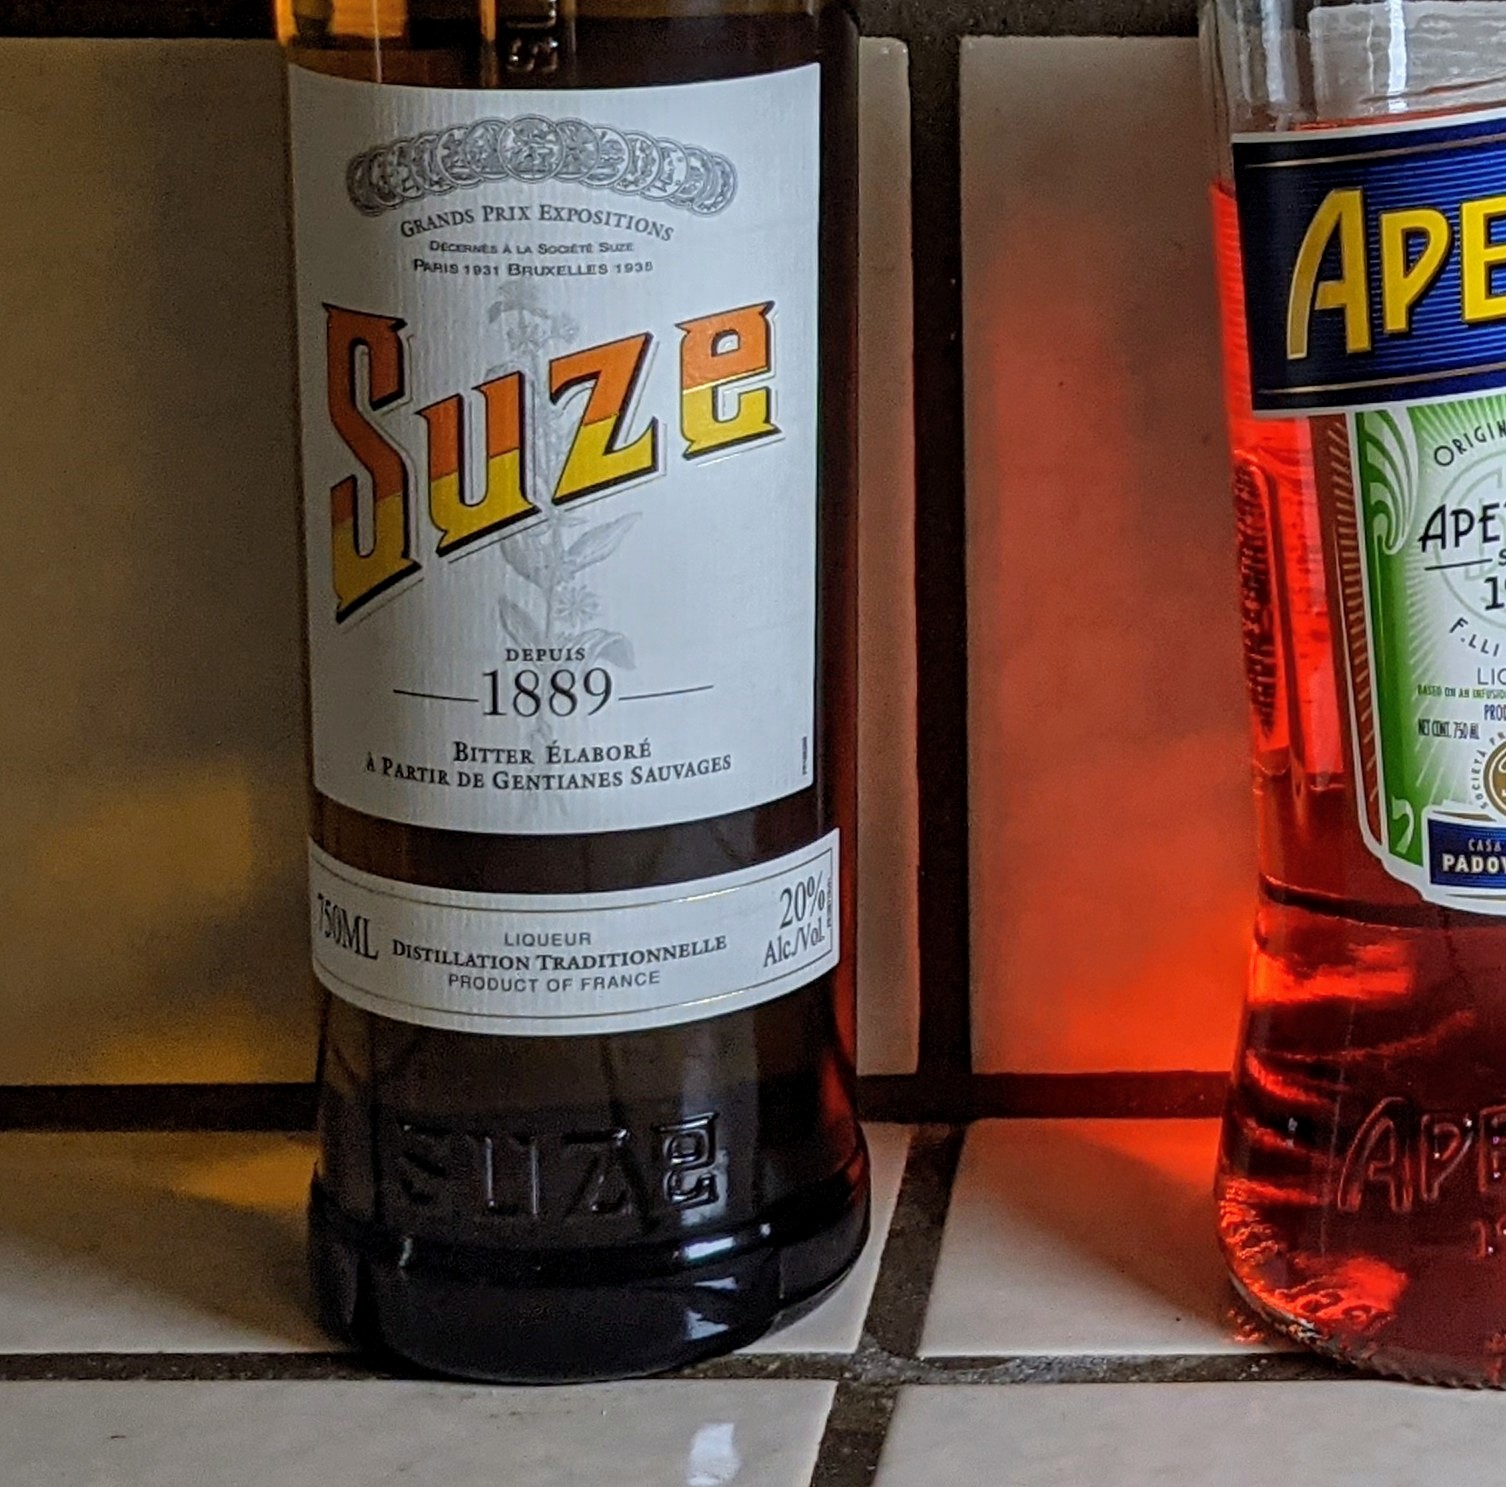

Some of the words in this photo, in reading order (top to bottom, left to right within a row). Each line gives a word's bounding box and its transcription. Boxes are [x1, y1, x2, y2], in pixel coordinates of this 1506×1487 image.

[400, 208, 474, 239] GRANDS
[482, 204, 531, 223] PRIX
[539, 204, 674, 242] EXPOSITIONS
[599, 241, 635, 253] SUZE
[414, 258, 459, 274] PARIS
[464, 264, 499, 276] 1931
[508, 262, 609, 276] BRUXELLES
[505, 647, 586, 662] DEPUIS
[481, 667, 613, 717] 1889
[453, 741, 535, 764] BITTER
[546, 738, 652, 764] ÉLABORÉ
[382, 756, 450, 786] PARTIR
[457, 771, 485, 788] DE
[492, 769, 623, 791] GENTIANES
[630, 754, 732, 785] SAUVAGES
[779, 870, 825, 929] 20%
[504, 932, 591, 947] LIQUEUR
[392, 939, 530, 971] DISTILLATION
[536, 935, 727, 971] TRADITIONNELLE
[448, 973, 537, 993] PRODUCT
[547, 977, 573, 992] OF
[580, 970, 661, 991] FRANCE
